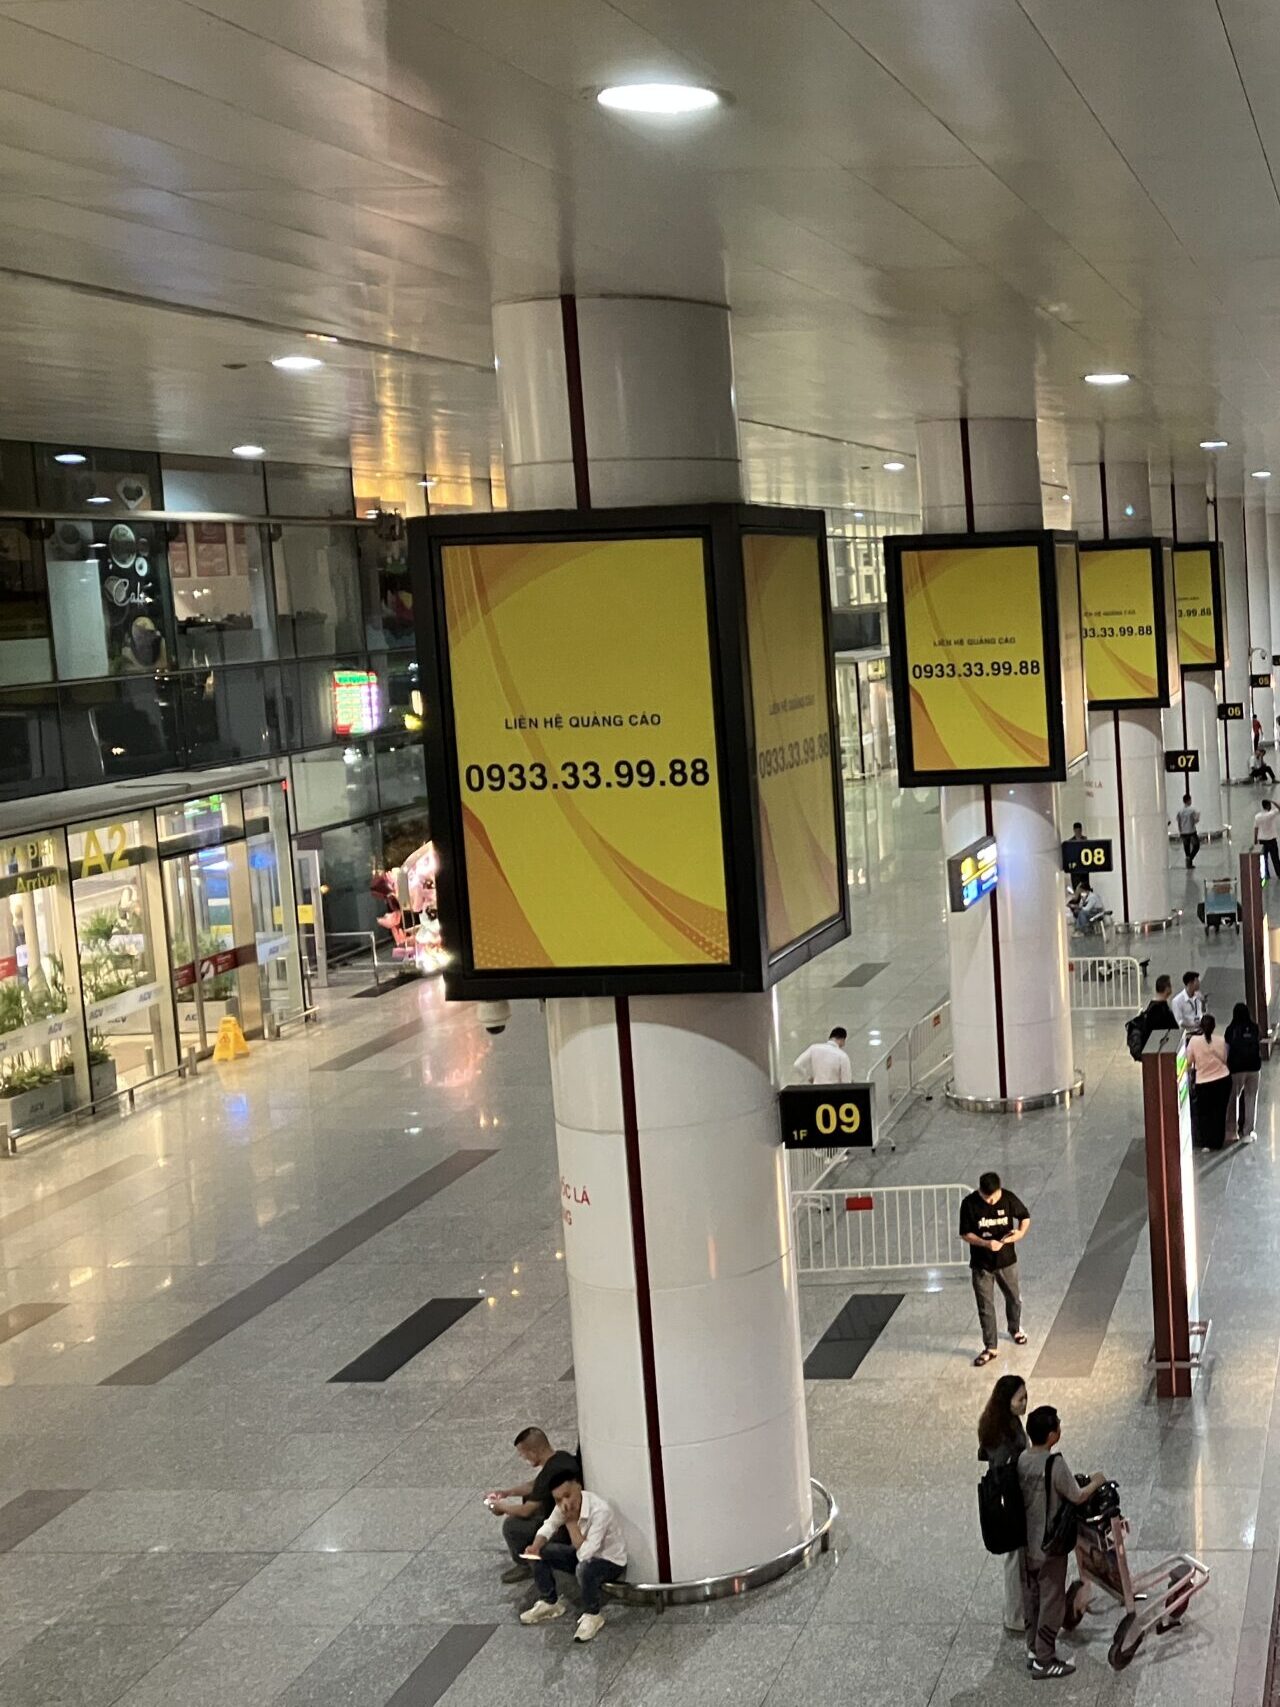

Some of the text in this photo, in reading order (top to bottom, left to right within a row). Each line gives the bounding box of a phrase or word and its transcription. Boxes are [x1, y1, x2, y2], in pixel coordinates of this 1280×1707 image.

[912, 660, 1040, 679] 0933.33.99.88
[504, 709, 661, 731] LIÊN HỆ QUẢNG CÁO
[1228, 706, 1241, 717] 06
[1177, 755, 1195, 768] 07
[465, 758, 710, 792] 0933.33.99.88
[81, 824, 129, 878] A2
[1081, 848, 1105, 866] 08
[16, 872, 60, 893] Arrival
[792, 1103, 860, 1140] 1F 09
